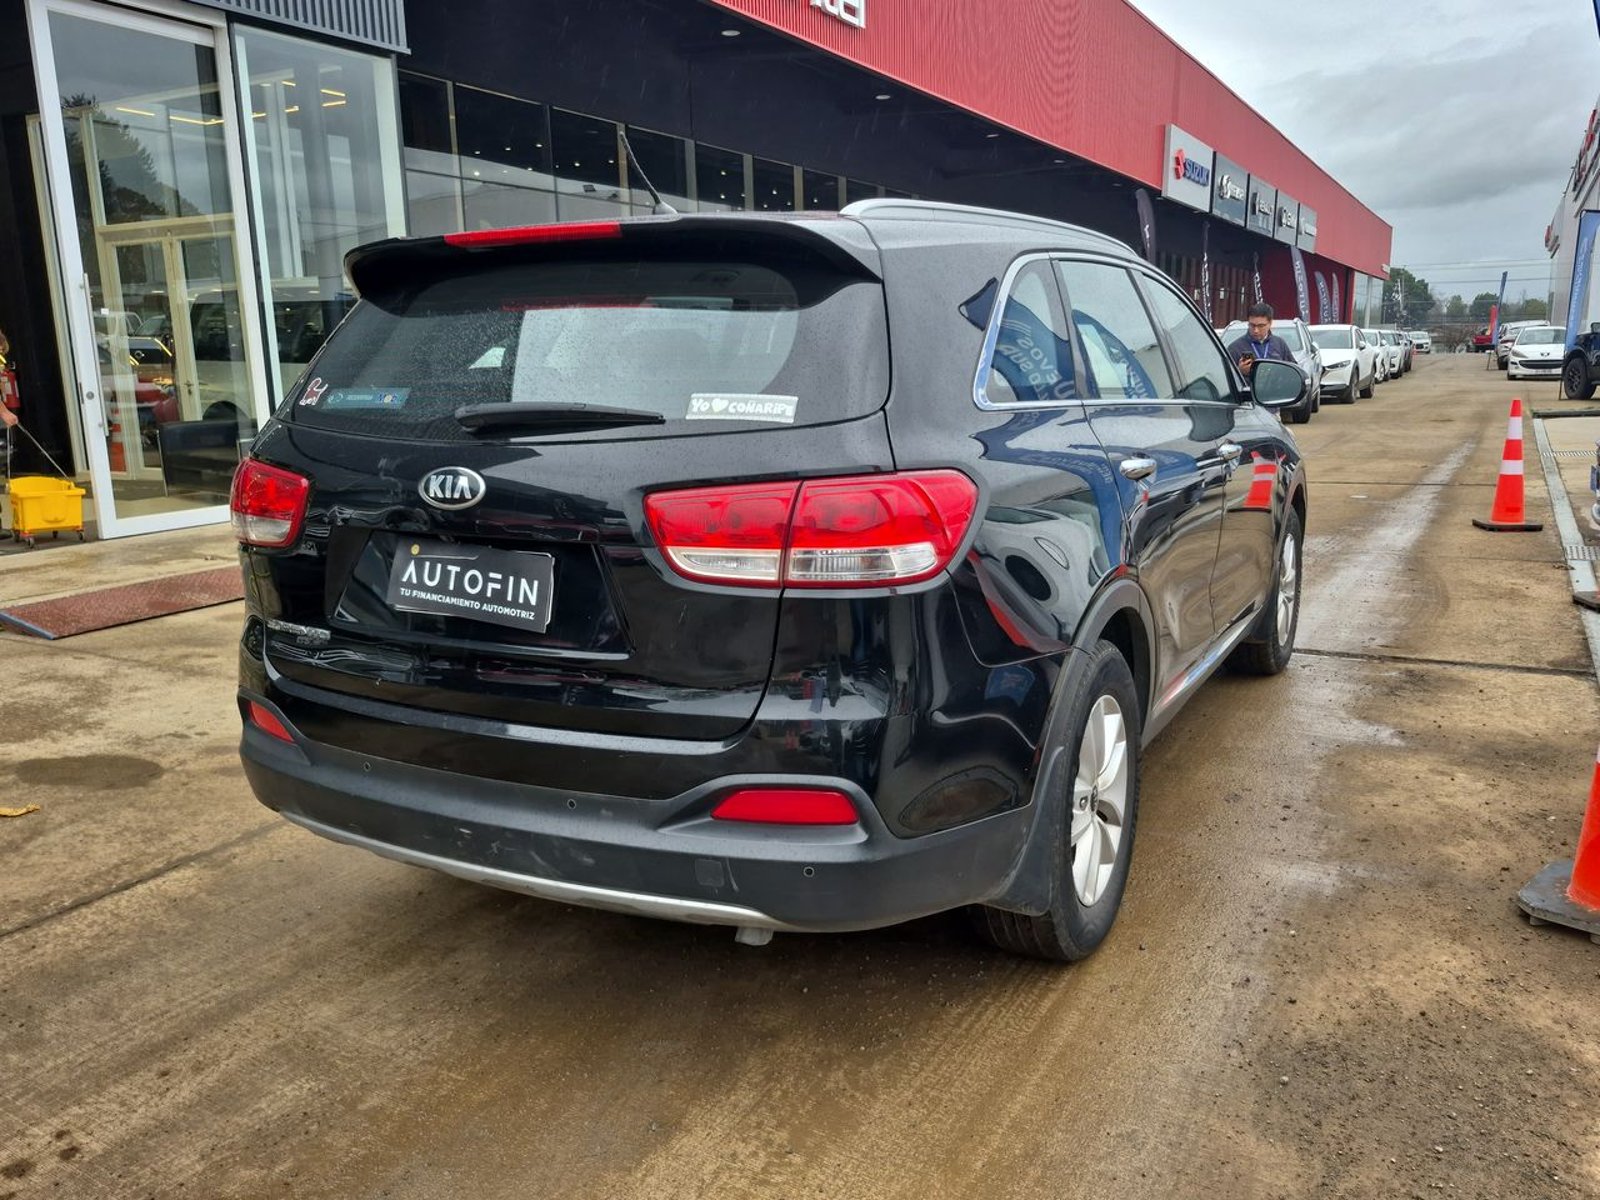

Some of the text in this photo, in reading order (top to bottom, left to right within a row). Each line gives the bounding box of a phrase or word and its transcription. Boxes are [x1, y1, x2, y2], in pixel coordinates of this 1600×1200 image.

[429, 475, 472, 499] KIA
[402, 560, 539, 606] AUTOFIN
[400, 588, 536, 621] TU FINANCIAMIENTO AUTOMOTRIZ
